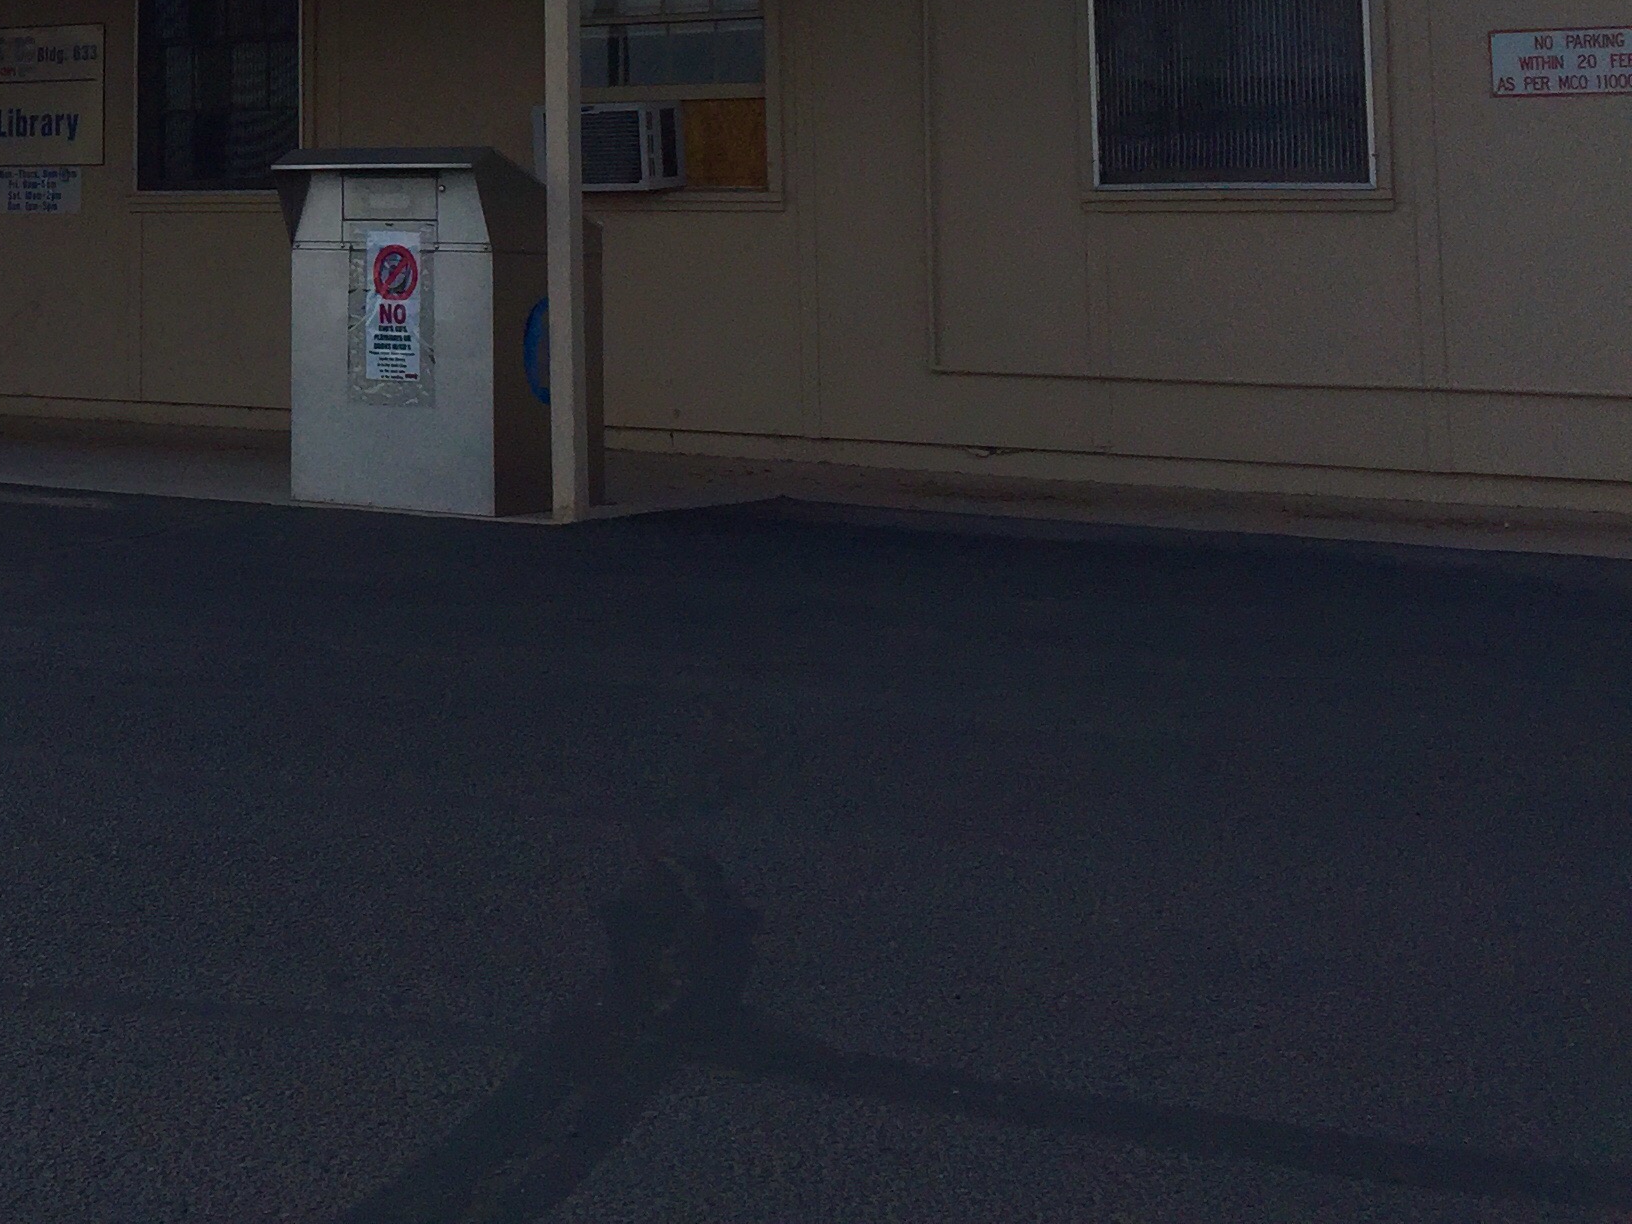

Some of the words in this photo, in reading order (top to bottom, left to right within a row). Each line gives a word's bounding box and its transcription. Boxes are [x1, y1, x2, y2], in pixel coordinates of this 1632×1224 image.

[1534, 35, 1553, 50] NO
[1566, 33, 1625, 49] PARKING
[1519, 55, 1564, 70] WITHIN
[1577, 54, 1597, 69] 20
[1498, 77, 1516, 91] AS
[1524, 76, 1551, 91] PER
[1558, 74, 1588, 89] MCO
[379, 303, 407, 324] NO
